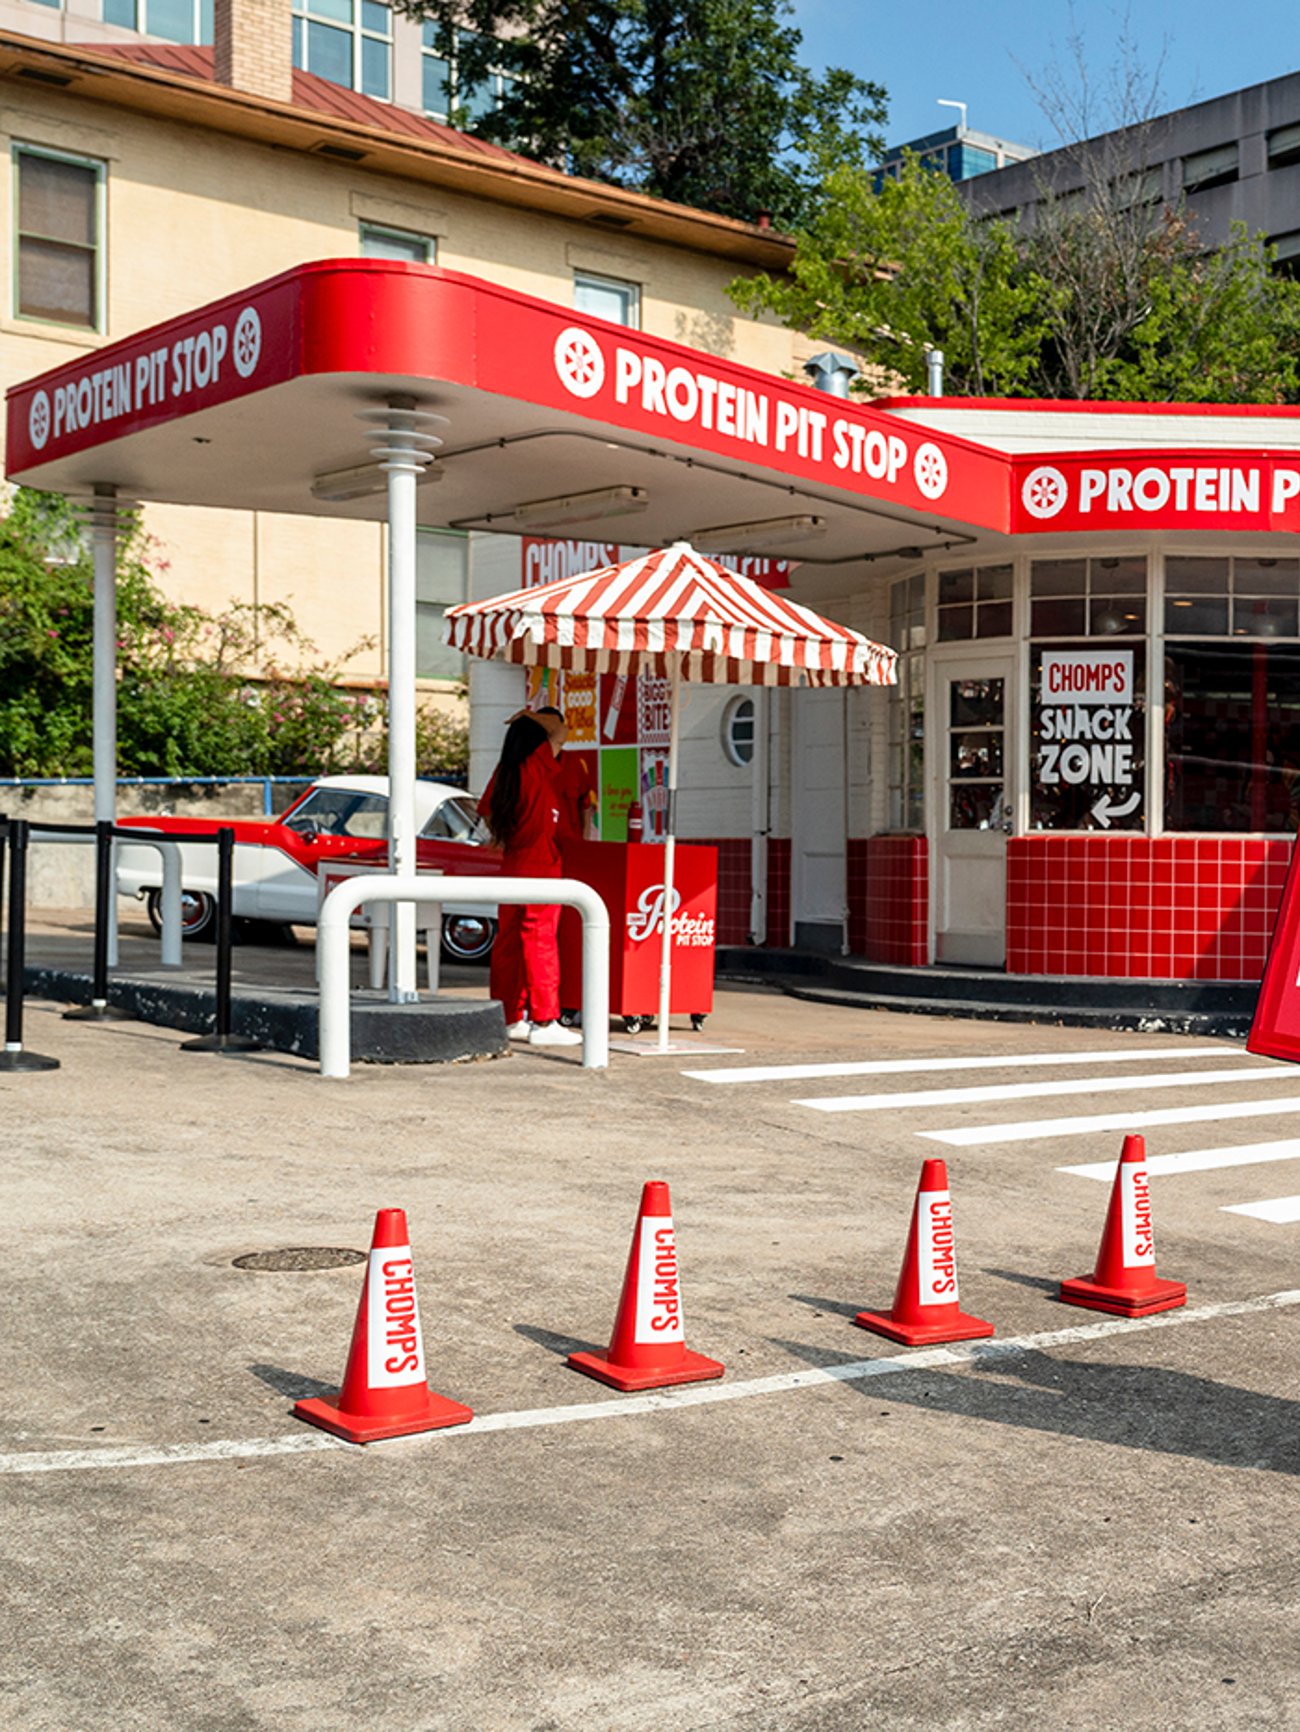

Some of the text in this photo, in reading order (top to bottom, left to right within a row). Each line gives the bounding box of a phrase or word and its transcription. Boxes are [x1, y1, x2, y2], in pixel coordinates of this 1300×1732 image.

[54, 325, 227, 437] PROTEIN PIT STOP
[616, 348, 907, 483] PROTEIN PIT STOP
[1079, 468, 1259, 512] PROTEIN
[1049, 662, 1126, 693] CHOMPS
[1037, 745, 1133, 784] ZONE
[1041, 708, 1133, 740] SNACK
[692, 934, 714, 946] STOP
[930, 1201, 955, 1294] CHOMPS
[1133, 1171, 1152, 1257] CHOMPS
[382, 1258, 419, 1374] CHOMPS
[651, 1228, 679, 1331] CHOMPS
